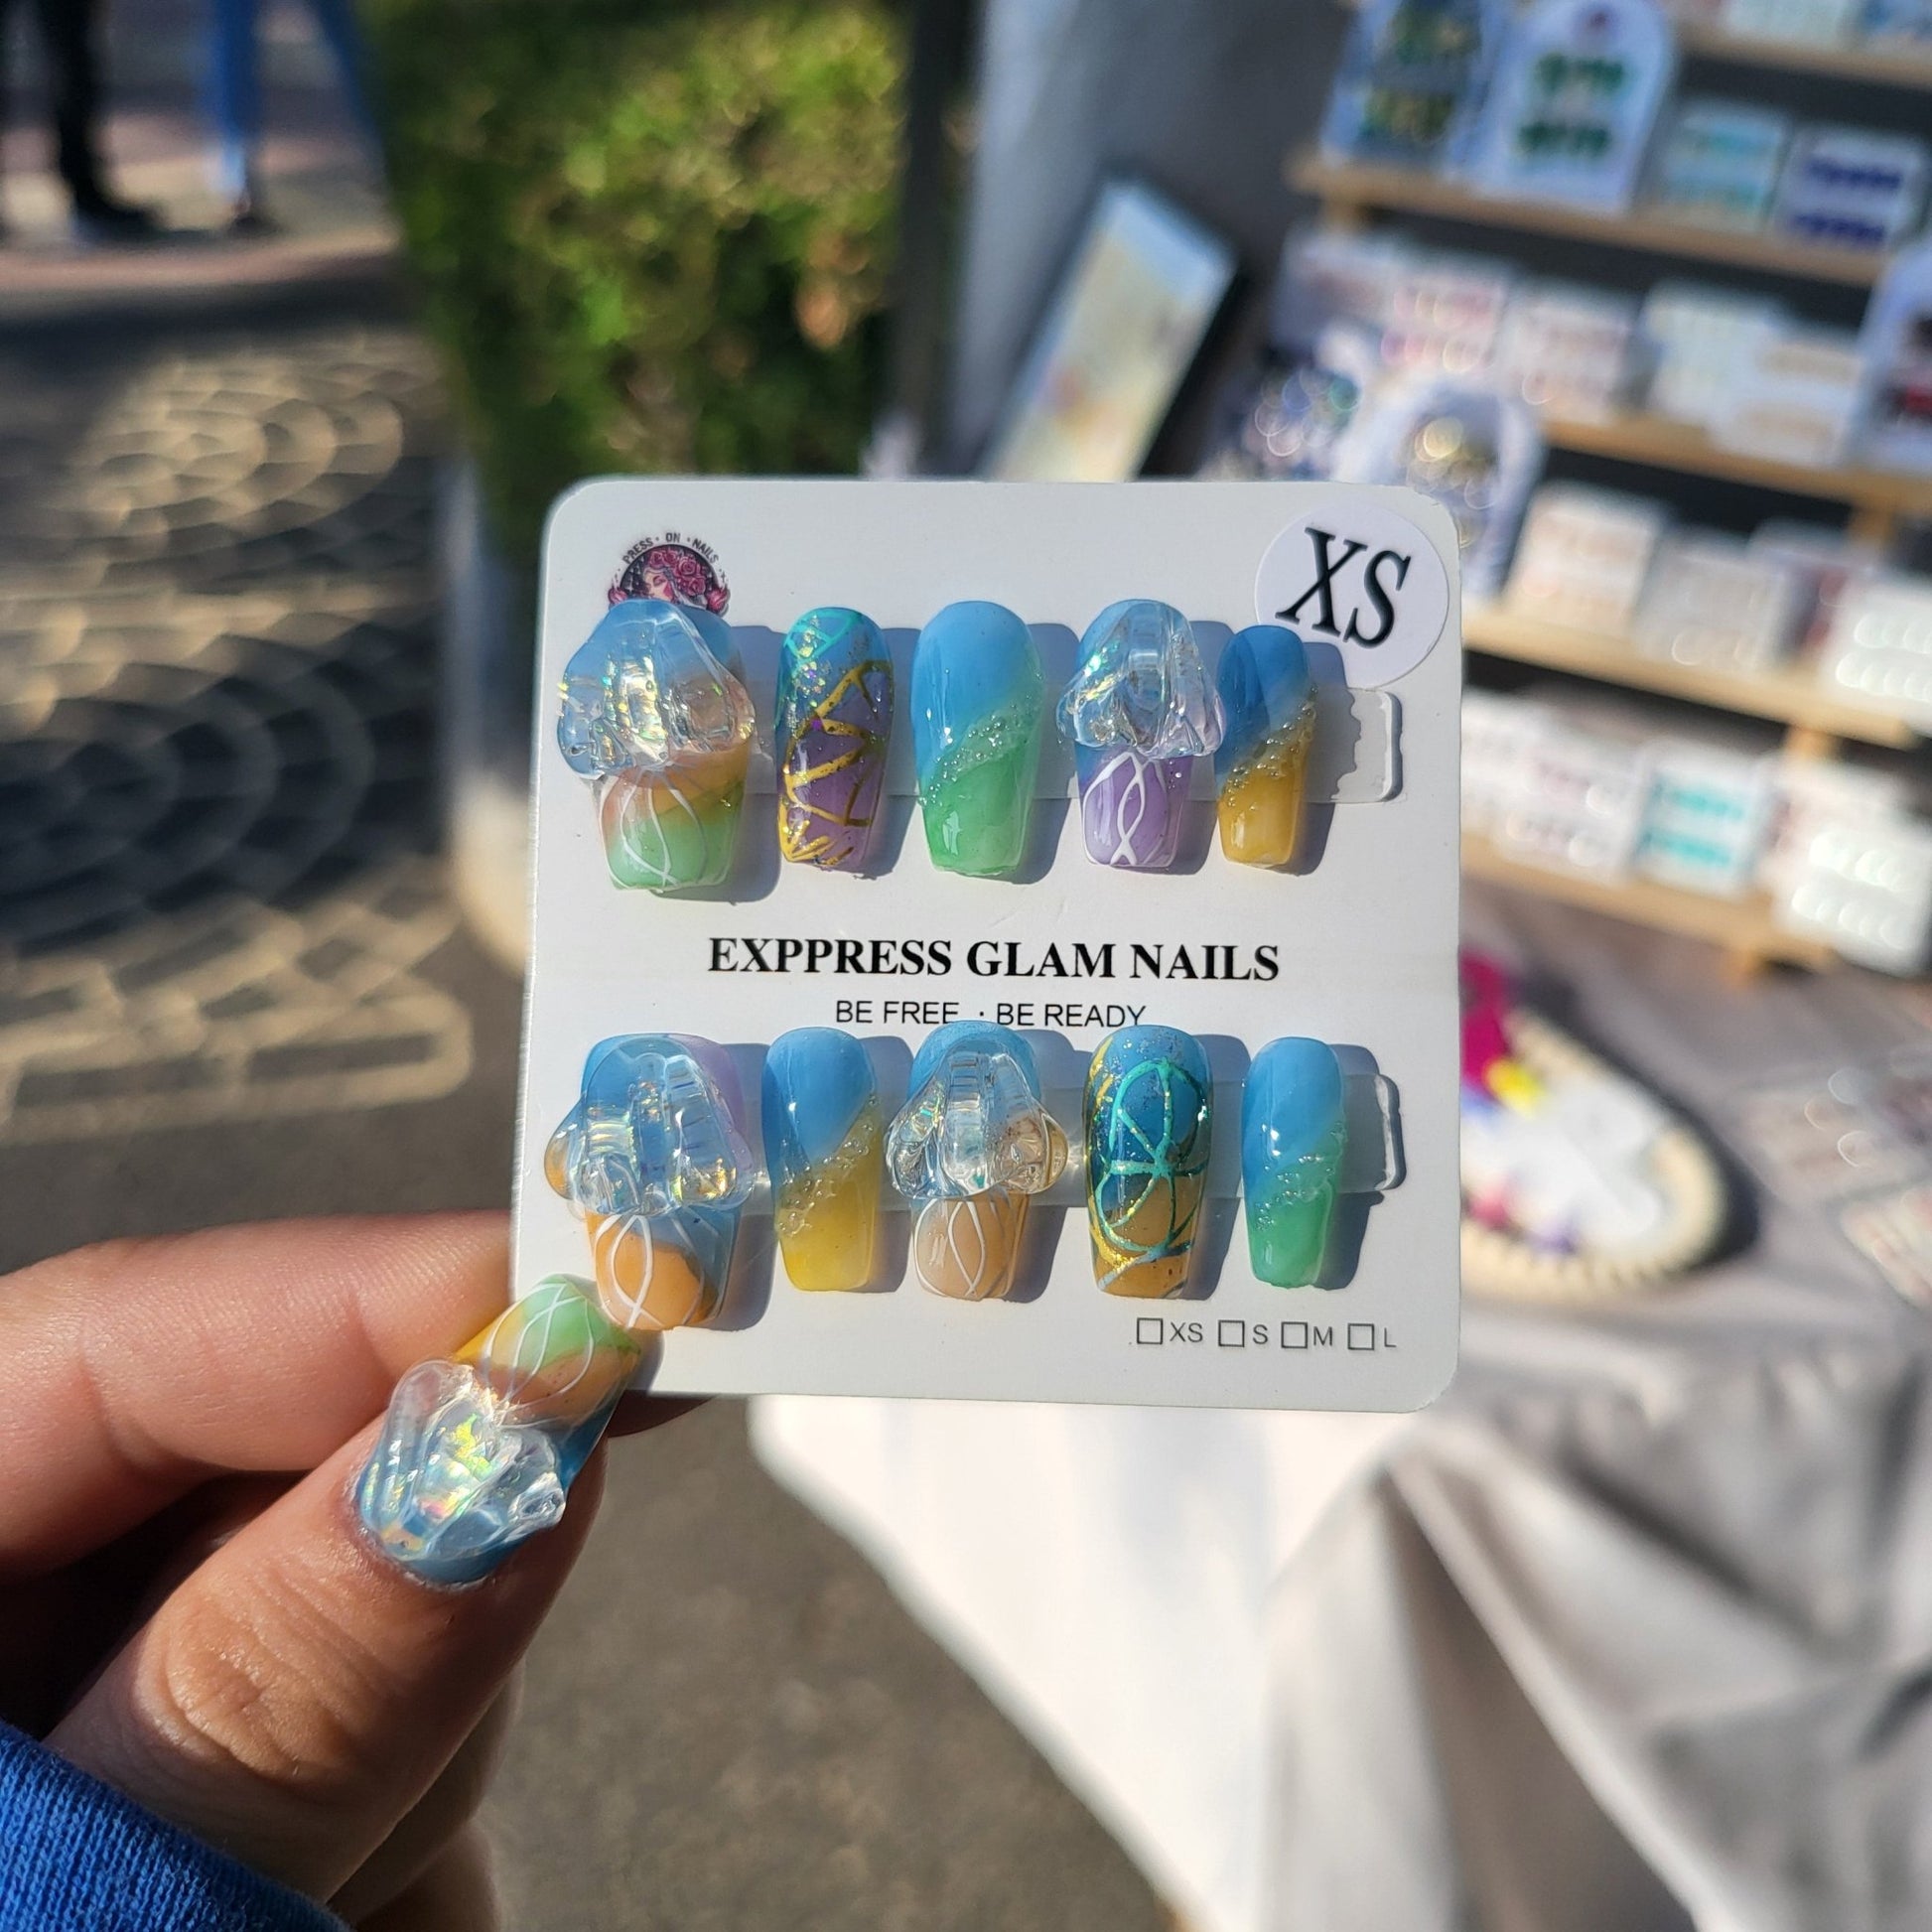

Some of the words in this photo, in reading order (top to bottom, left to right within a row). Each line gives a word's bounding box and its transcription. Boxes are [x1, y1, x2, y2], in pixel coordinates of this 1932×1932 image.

[621, 537, 654, 564] PRESS
[665, 532, 681, 543] ON
[692, 537, 720, 564] NAILS
[1275, 526, 1412, 649] XS
[708, 937, 952, 976] EXPPRESS
[966, 940, 1117, 978] GLAM
[1129, 943, 1280, 981] NAILS
[836, 1000, 873, 1023] BE
[884, 1001, 959, 1024] FREE
[996, 1003, 1035, 1026] BE
[1044, 1004, 1147, 1028] READY
[1169, 1321, 1203, 1343] XS
[1252, 1323, 1269, 1345] S
[1312, 1325, 1333, 1346] M
[1384, 1326, 1397, 1348] L
